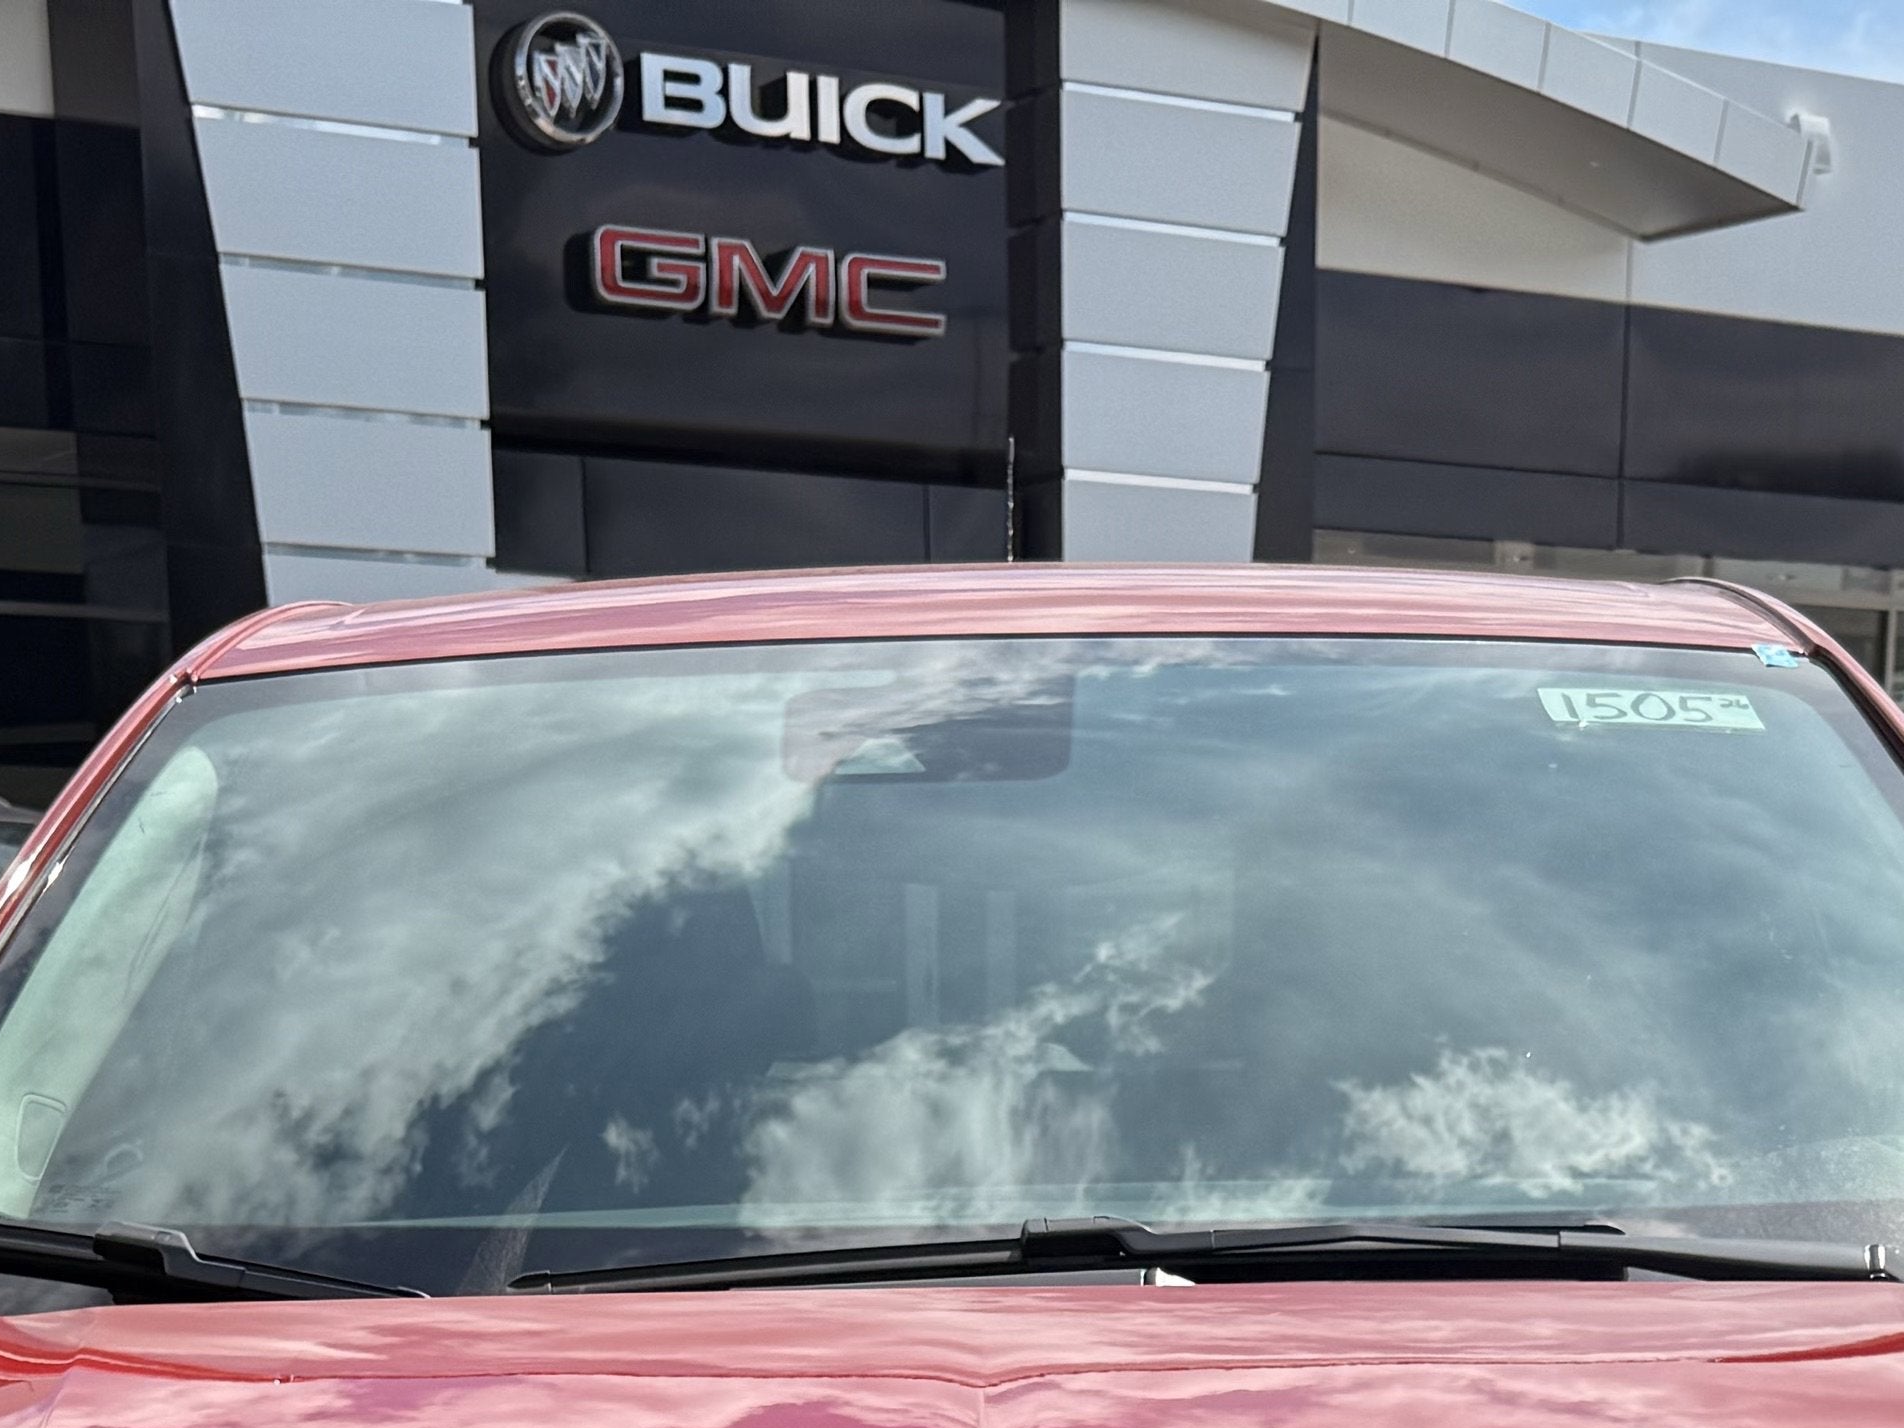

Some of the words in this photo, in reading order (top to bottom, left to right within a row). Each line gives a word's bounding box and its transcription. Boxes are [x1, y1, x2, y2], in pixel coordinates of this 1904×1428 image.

[640, 52, 1005, 166] BUICK
[594, 224, 947, 336] GMC
[1561, 692, 1713, 723] 1505
